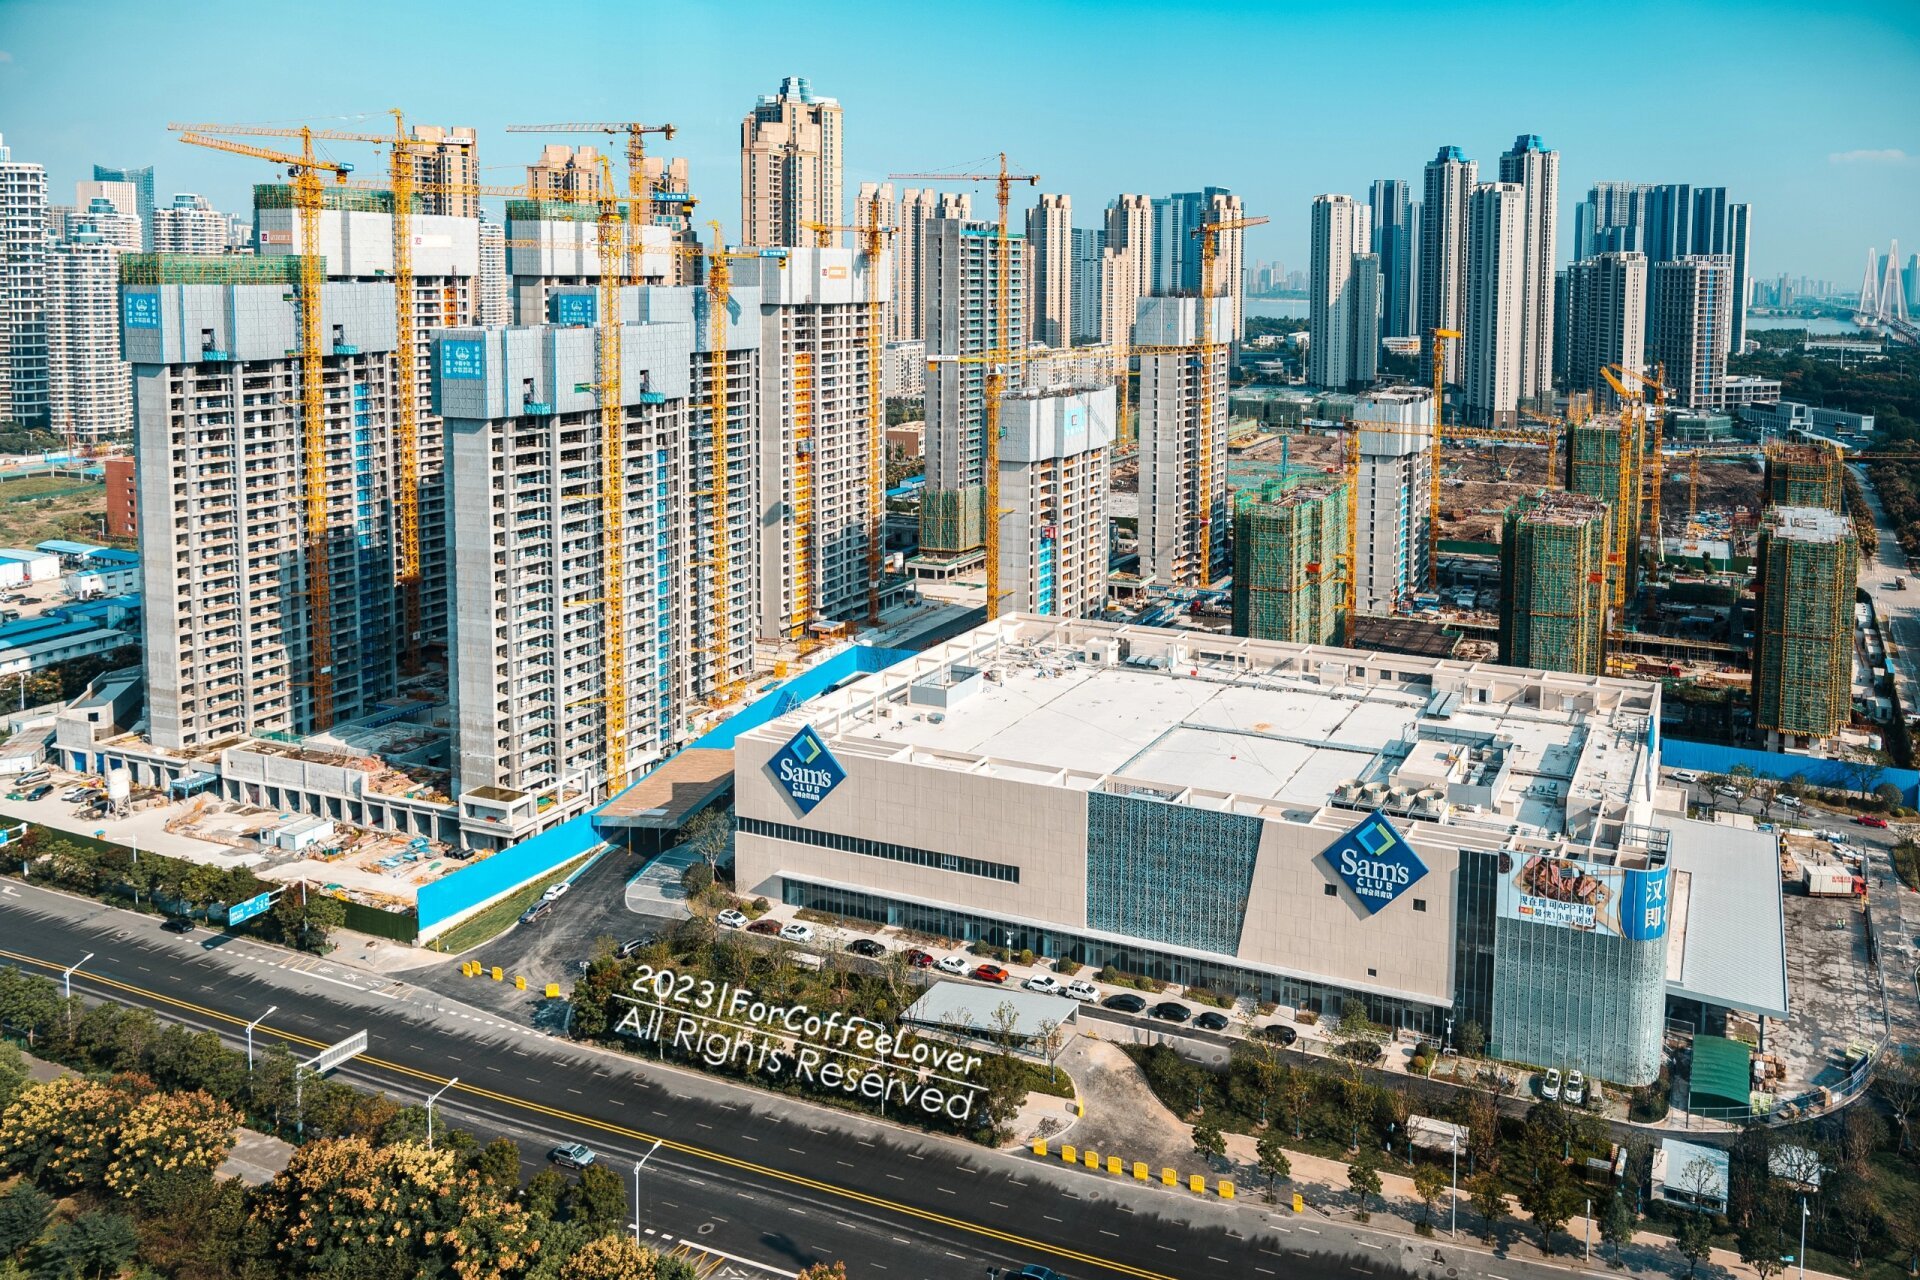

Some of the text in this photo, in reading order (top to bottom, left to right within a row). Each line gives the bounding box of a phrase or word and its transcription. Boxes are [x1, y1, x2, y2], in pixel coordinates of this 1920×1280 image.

[780, 758, 832, 788] Sam's
[792, 782, 820, 794] CLUB
[1340, 848, 1410, 885] Sam's
[1356, 877, 1393, 891] CLUB
[1646, 879, 1667, 902] 汉
[1645, 906, 1666, 928] 即
